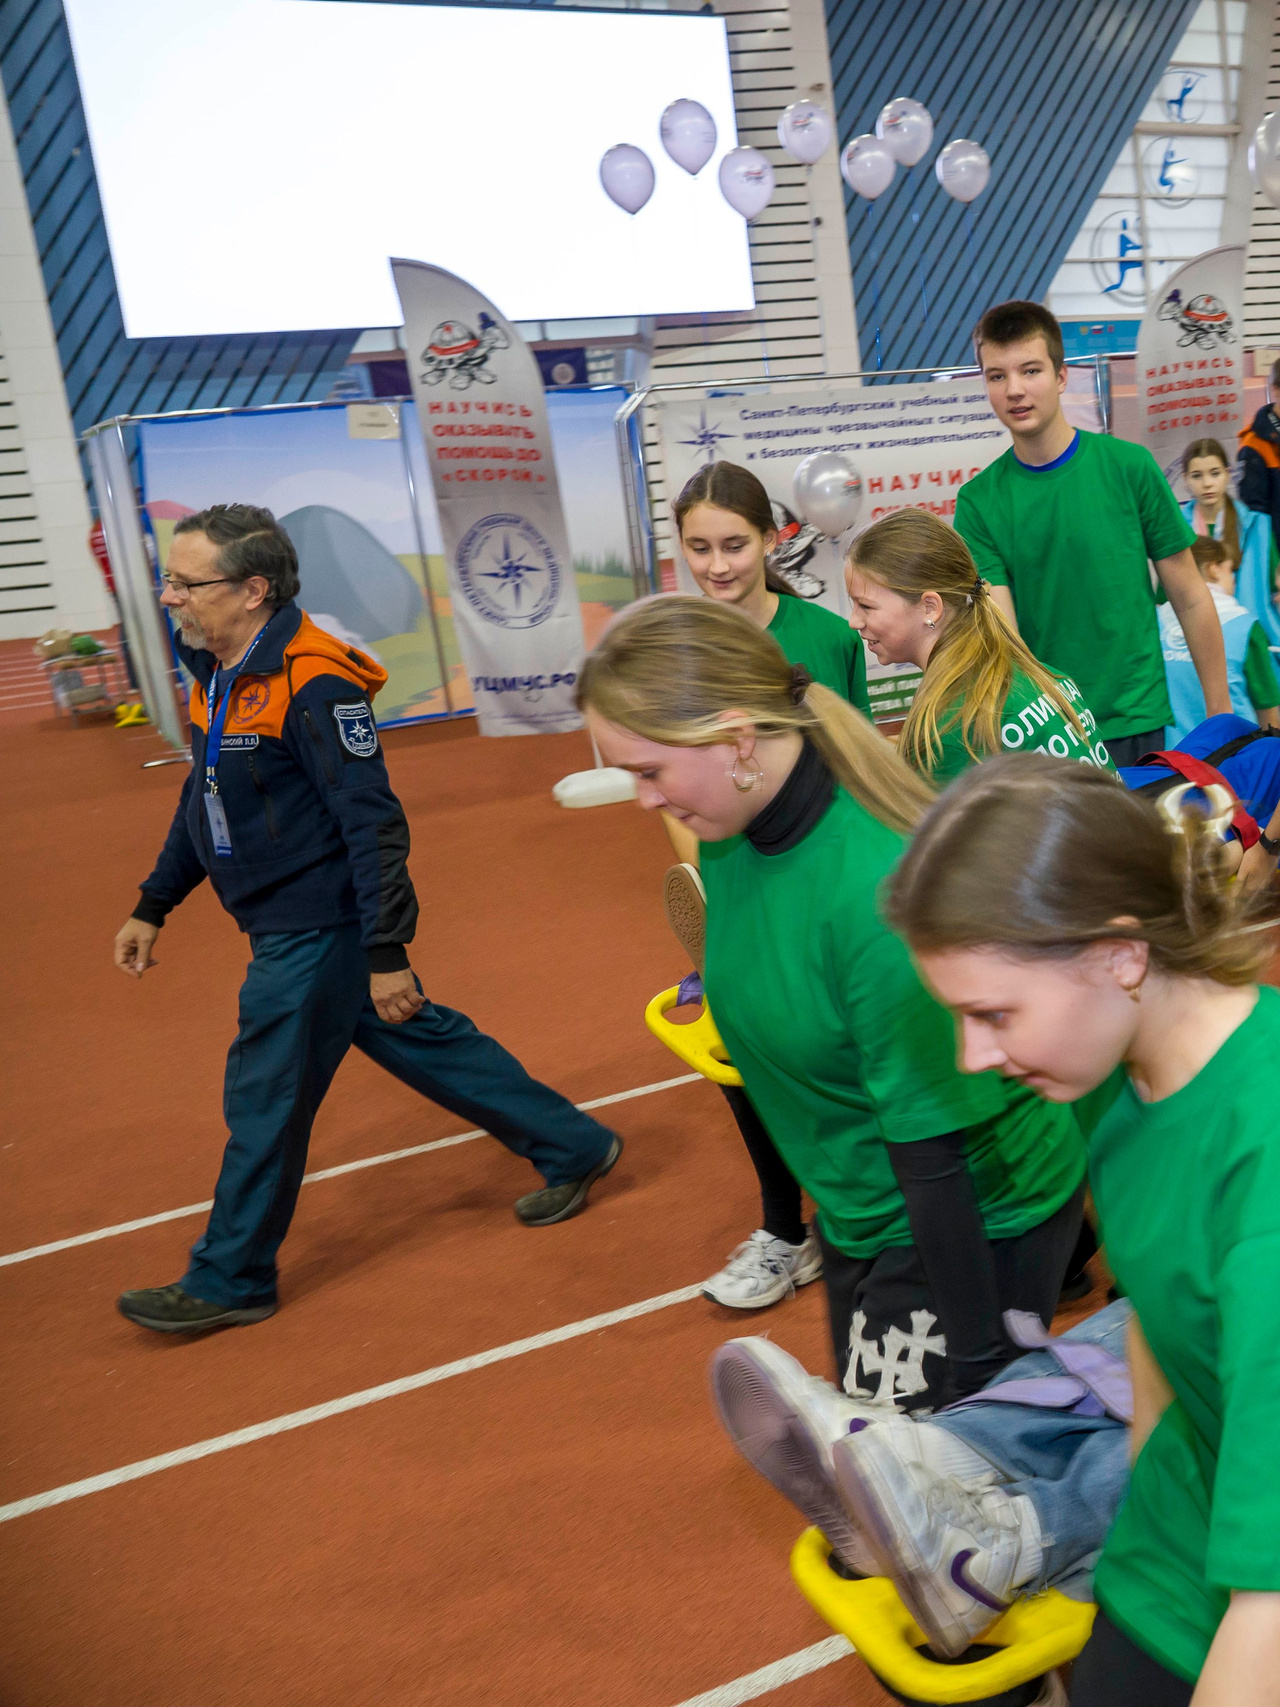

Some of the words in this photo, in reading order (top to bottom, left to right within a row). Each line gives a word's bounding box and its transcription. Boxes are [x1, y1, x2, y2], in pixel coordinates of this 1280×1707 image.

[1145, 356, 1235, 379] НАУЧИСЬ
[1146, 375, 1235, 397] ОКАЗЫВАТЬ
[427, 401, 533, 418] НАУЧИСЬ
[740, 398, 895, 420] Санкт-Петербургский
[900, 393, 959, 411] учебный
[962, 394, 988, 404] цен
[1147, 396, 1213, 416] ПОМОЩЬ
[1216, 393, 1238, 406] ДО
[432, 423, 537, 439] ОКАЗЫВАТЬ
[743, 426, 823, 440] медицины
[826, 416, 934, 435] чрезвычайных
